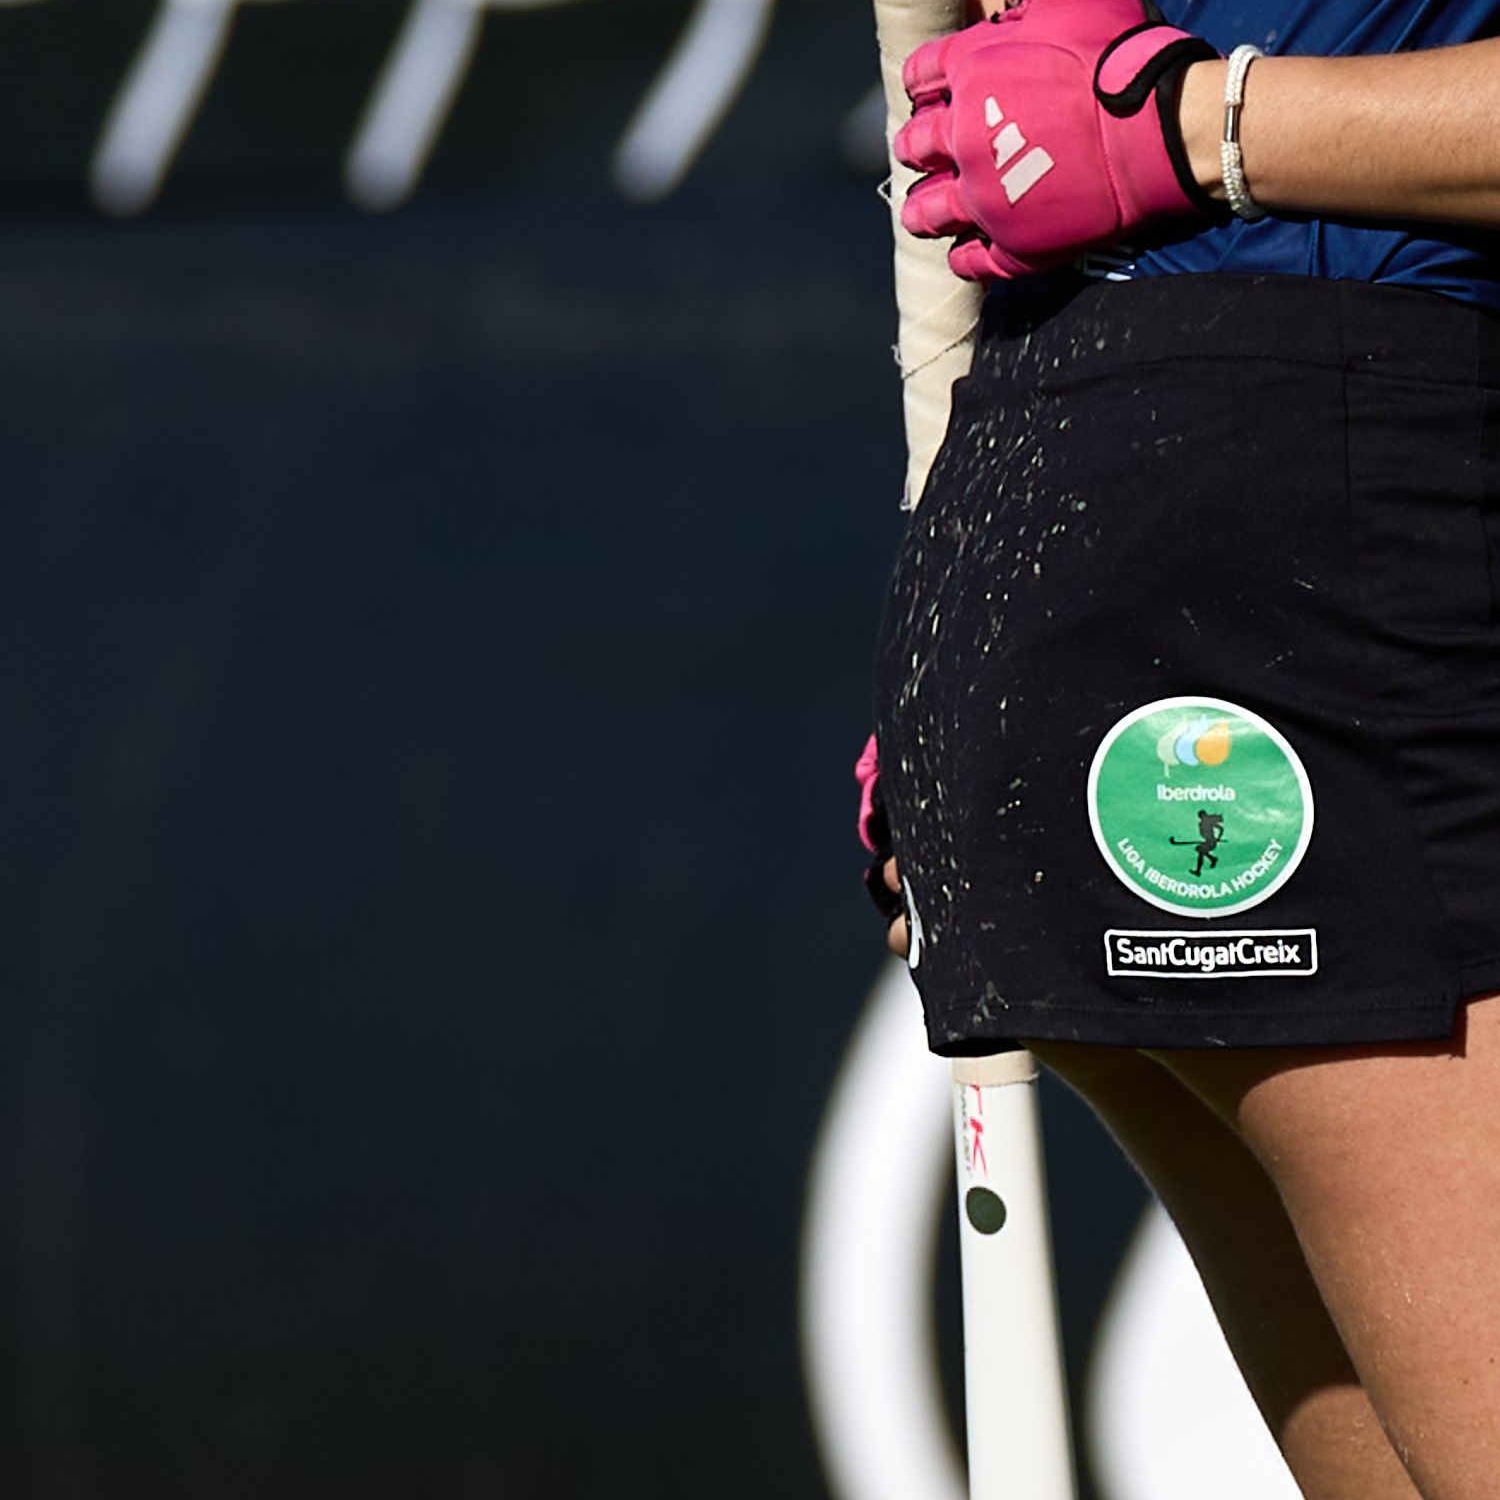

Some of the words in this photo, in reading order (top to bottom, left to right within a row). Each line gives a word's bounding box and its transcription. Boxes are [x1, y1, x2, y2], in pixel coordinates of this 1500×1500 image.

[1156, 783, 1237, 802] Iberdrola
[1116, 837, 1146, 876] LIGA
[1144, 864, 1233, 899] IBERDROLA
[1231, 837, 1284, 891] HOCKEY
[1116, 937, 1301, 973] SantCugatCreix
